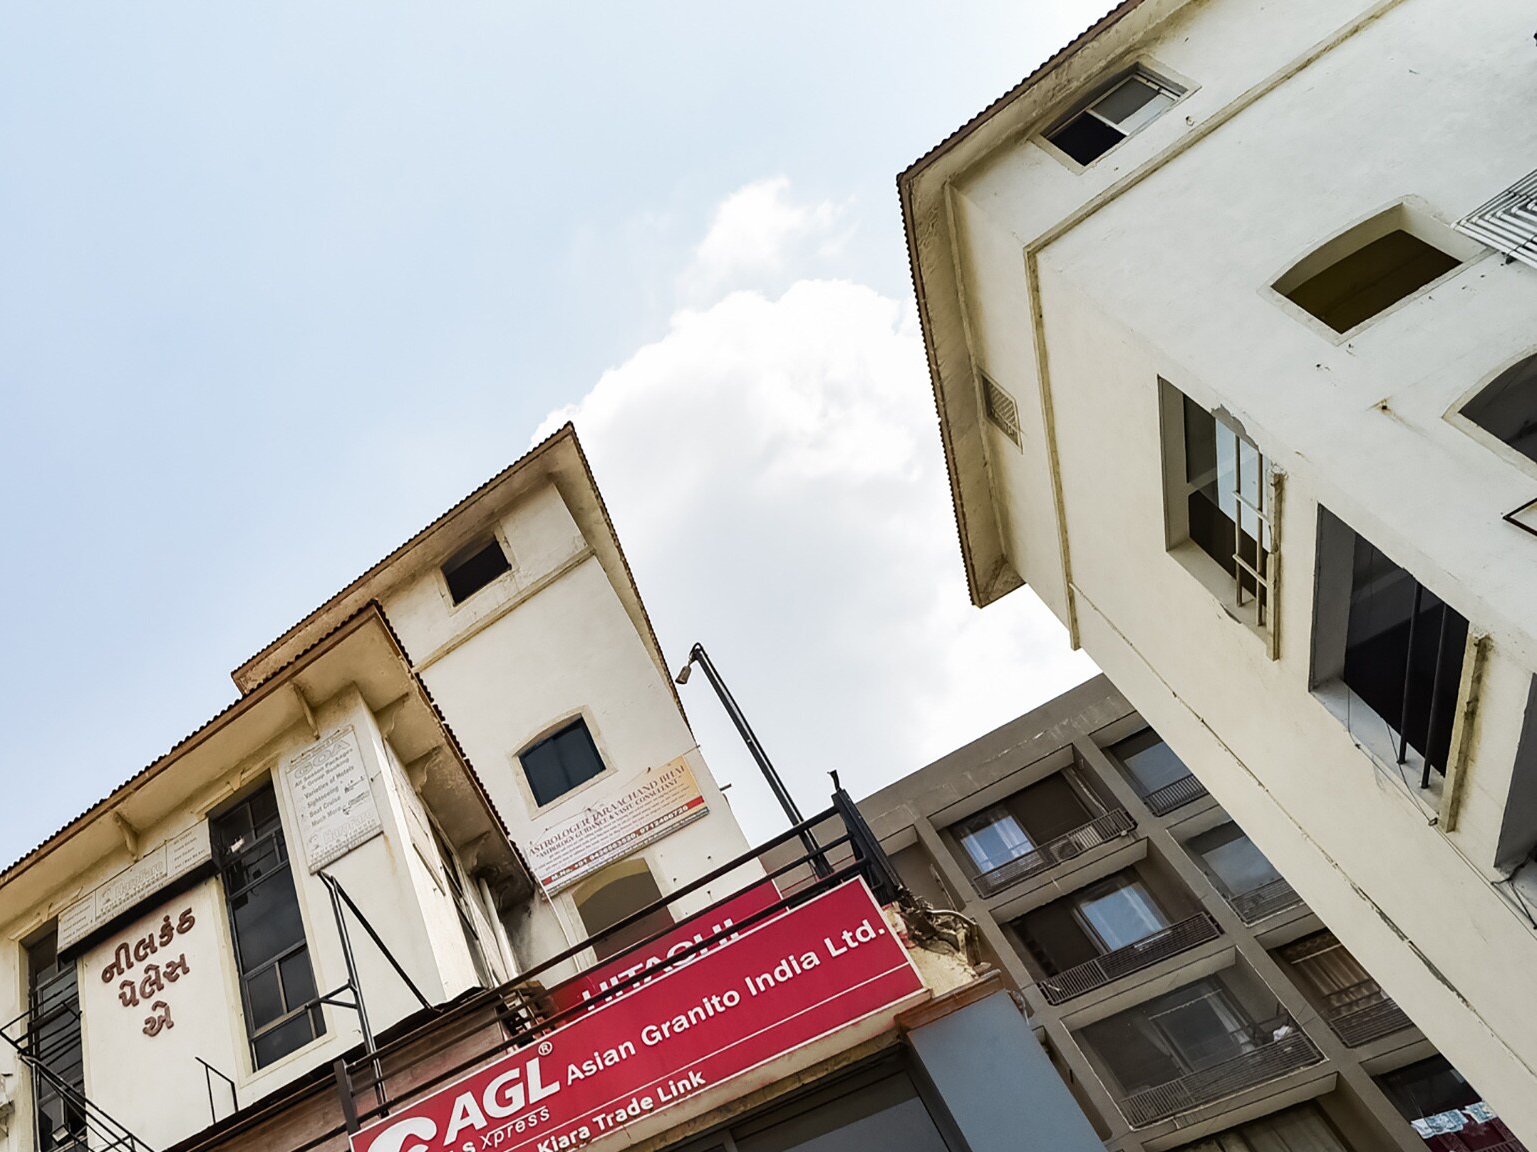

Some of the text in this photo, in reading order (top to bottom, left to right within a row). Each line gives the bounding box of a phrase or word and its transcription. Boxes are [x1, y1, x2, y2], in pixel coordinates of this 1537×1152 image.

[530, 817, 591, 855] ASTROLOGER
[101, 907, 196, 984] નીલકંઠ
[444, 918, 887, 1146] AGL Asian Granito India Ltd.
[592, 1095, 654, 1133] Trade
[656, 1069, 707, 1104] Link
